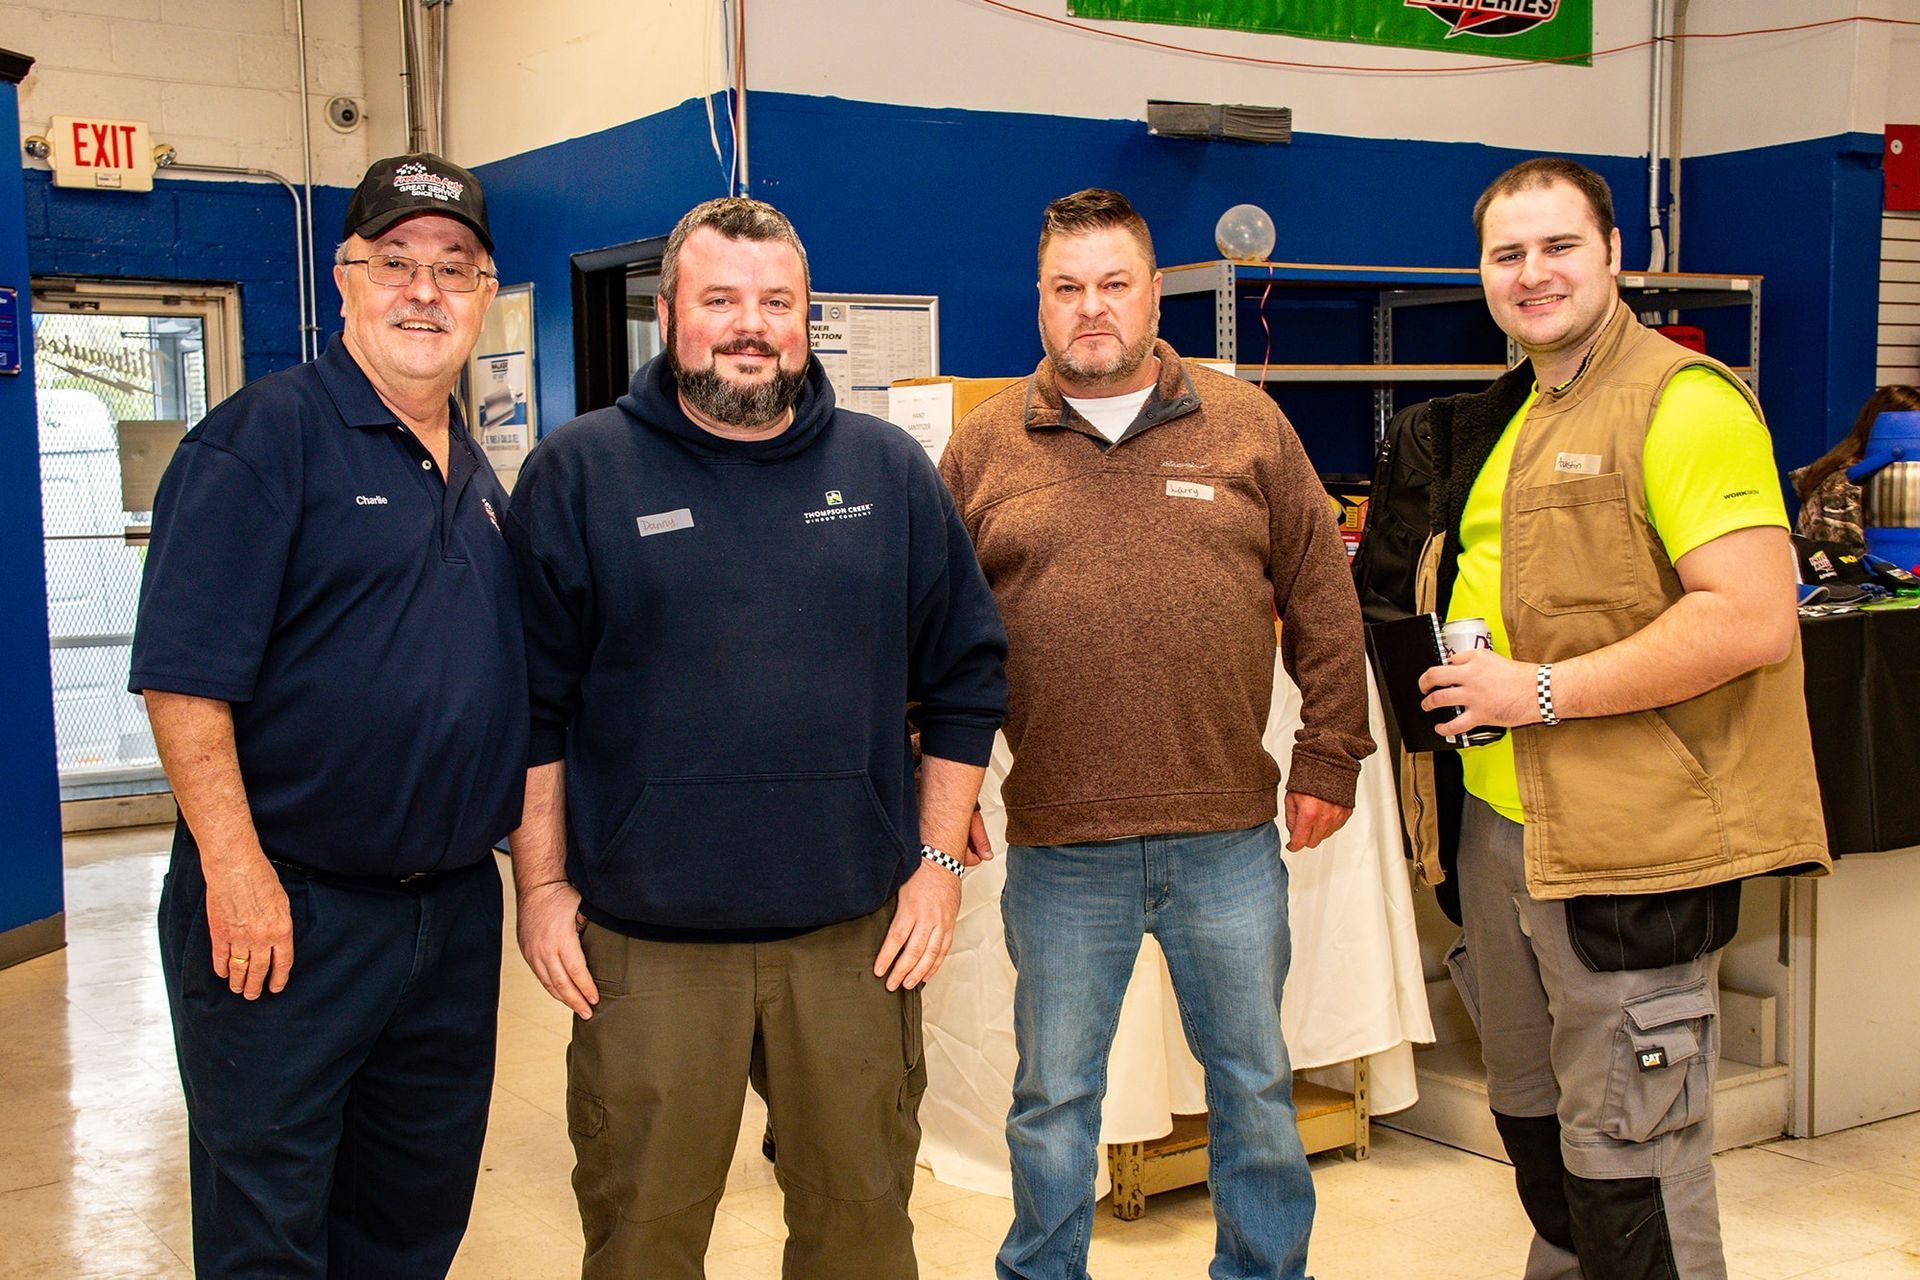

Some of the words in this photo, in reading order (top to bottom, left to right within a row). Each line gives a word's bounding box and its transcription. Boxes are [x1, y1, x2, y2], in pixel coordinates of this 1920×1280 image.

[73, 123, 136, 169] EXIT
[400, 184, 427, 192] GREAT
[427, 185, 461, 200] SERVICE
[355, 495, 388, 505] Charlie
[803, 507, 847, 519] THOMPSON
[847, 504, 871, 513] CREEK
[805, 516, 836, 524] WINDOW
[839, 511, 872, 520] COMPANY
[641, 518, 676, 531] Danny
[1641, 1053, 1661, 1067] CAT
